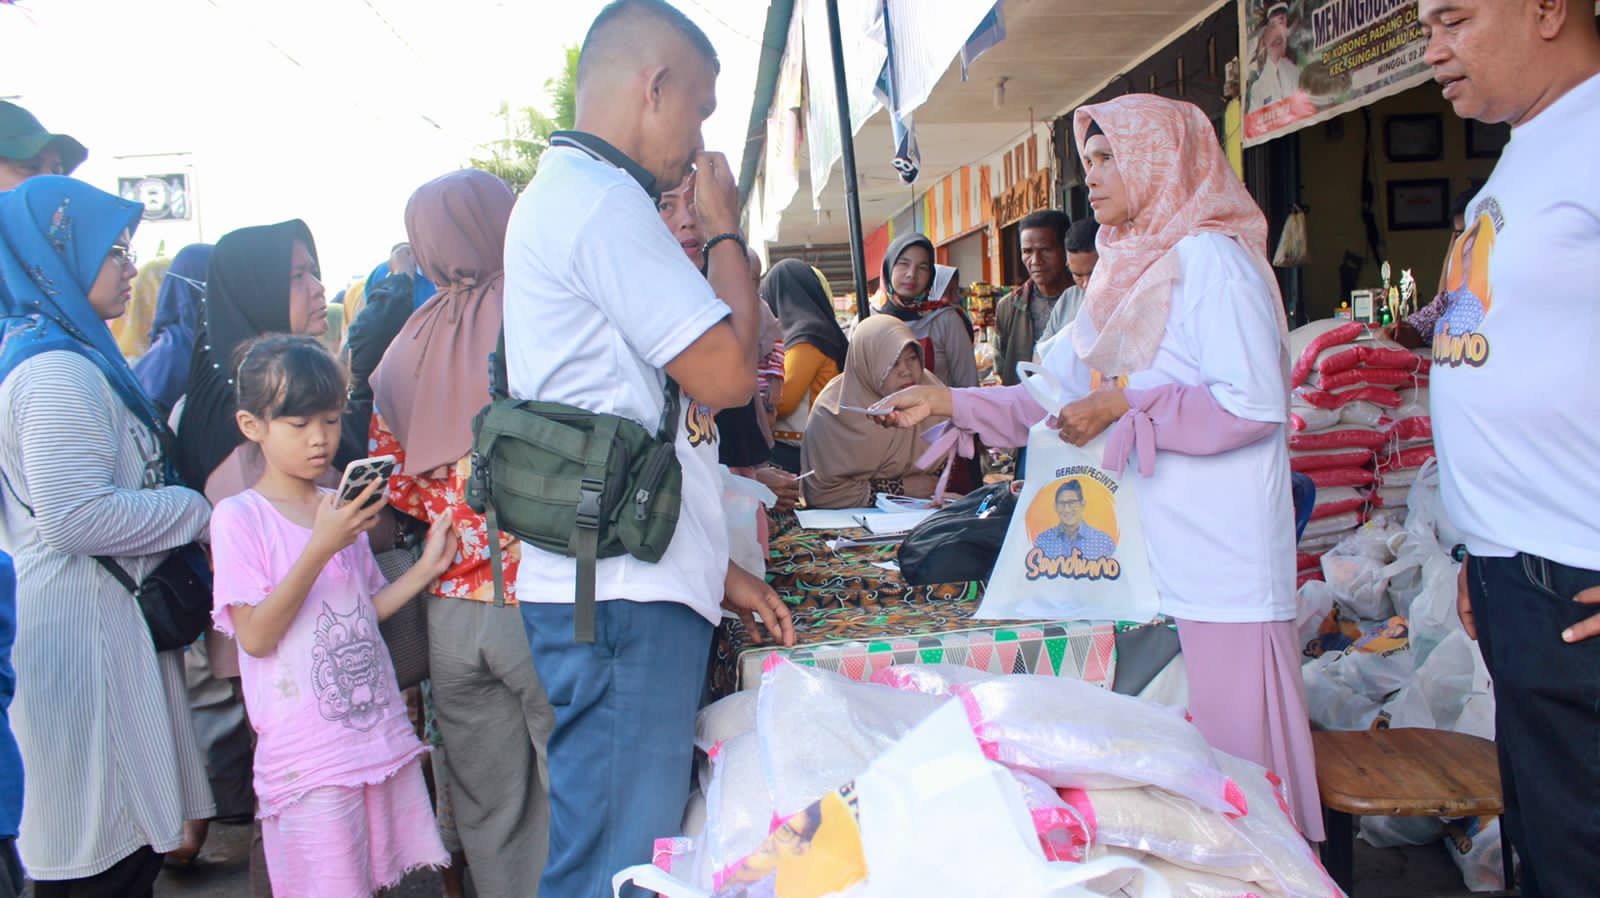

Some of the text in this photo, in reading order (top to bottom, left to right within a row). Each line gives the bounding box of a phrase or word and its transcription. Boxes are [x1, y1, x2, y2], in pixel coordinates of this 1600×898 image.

[1332, 33, 1368, 59] KORONG
[1369, 15, 1402, 41] PADANG
[1347, 44, 1380, 69] SUNGAI
[1381, 31, 1407, 54] LIMAU
[1088, 466, 1119, 494] PECINTA
